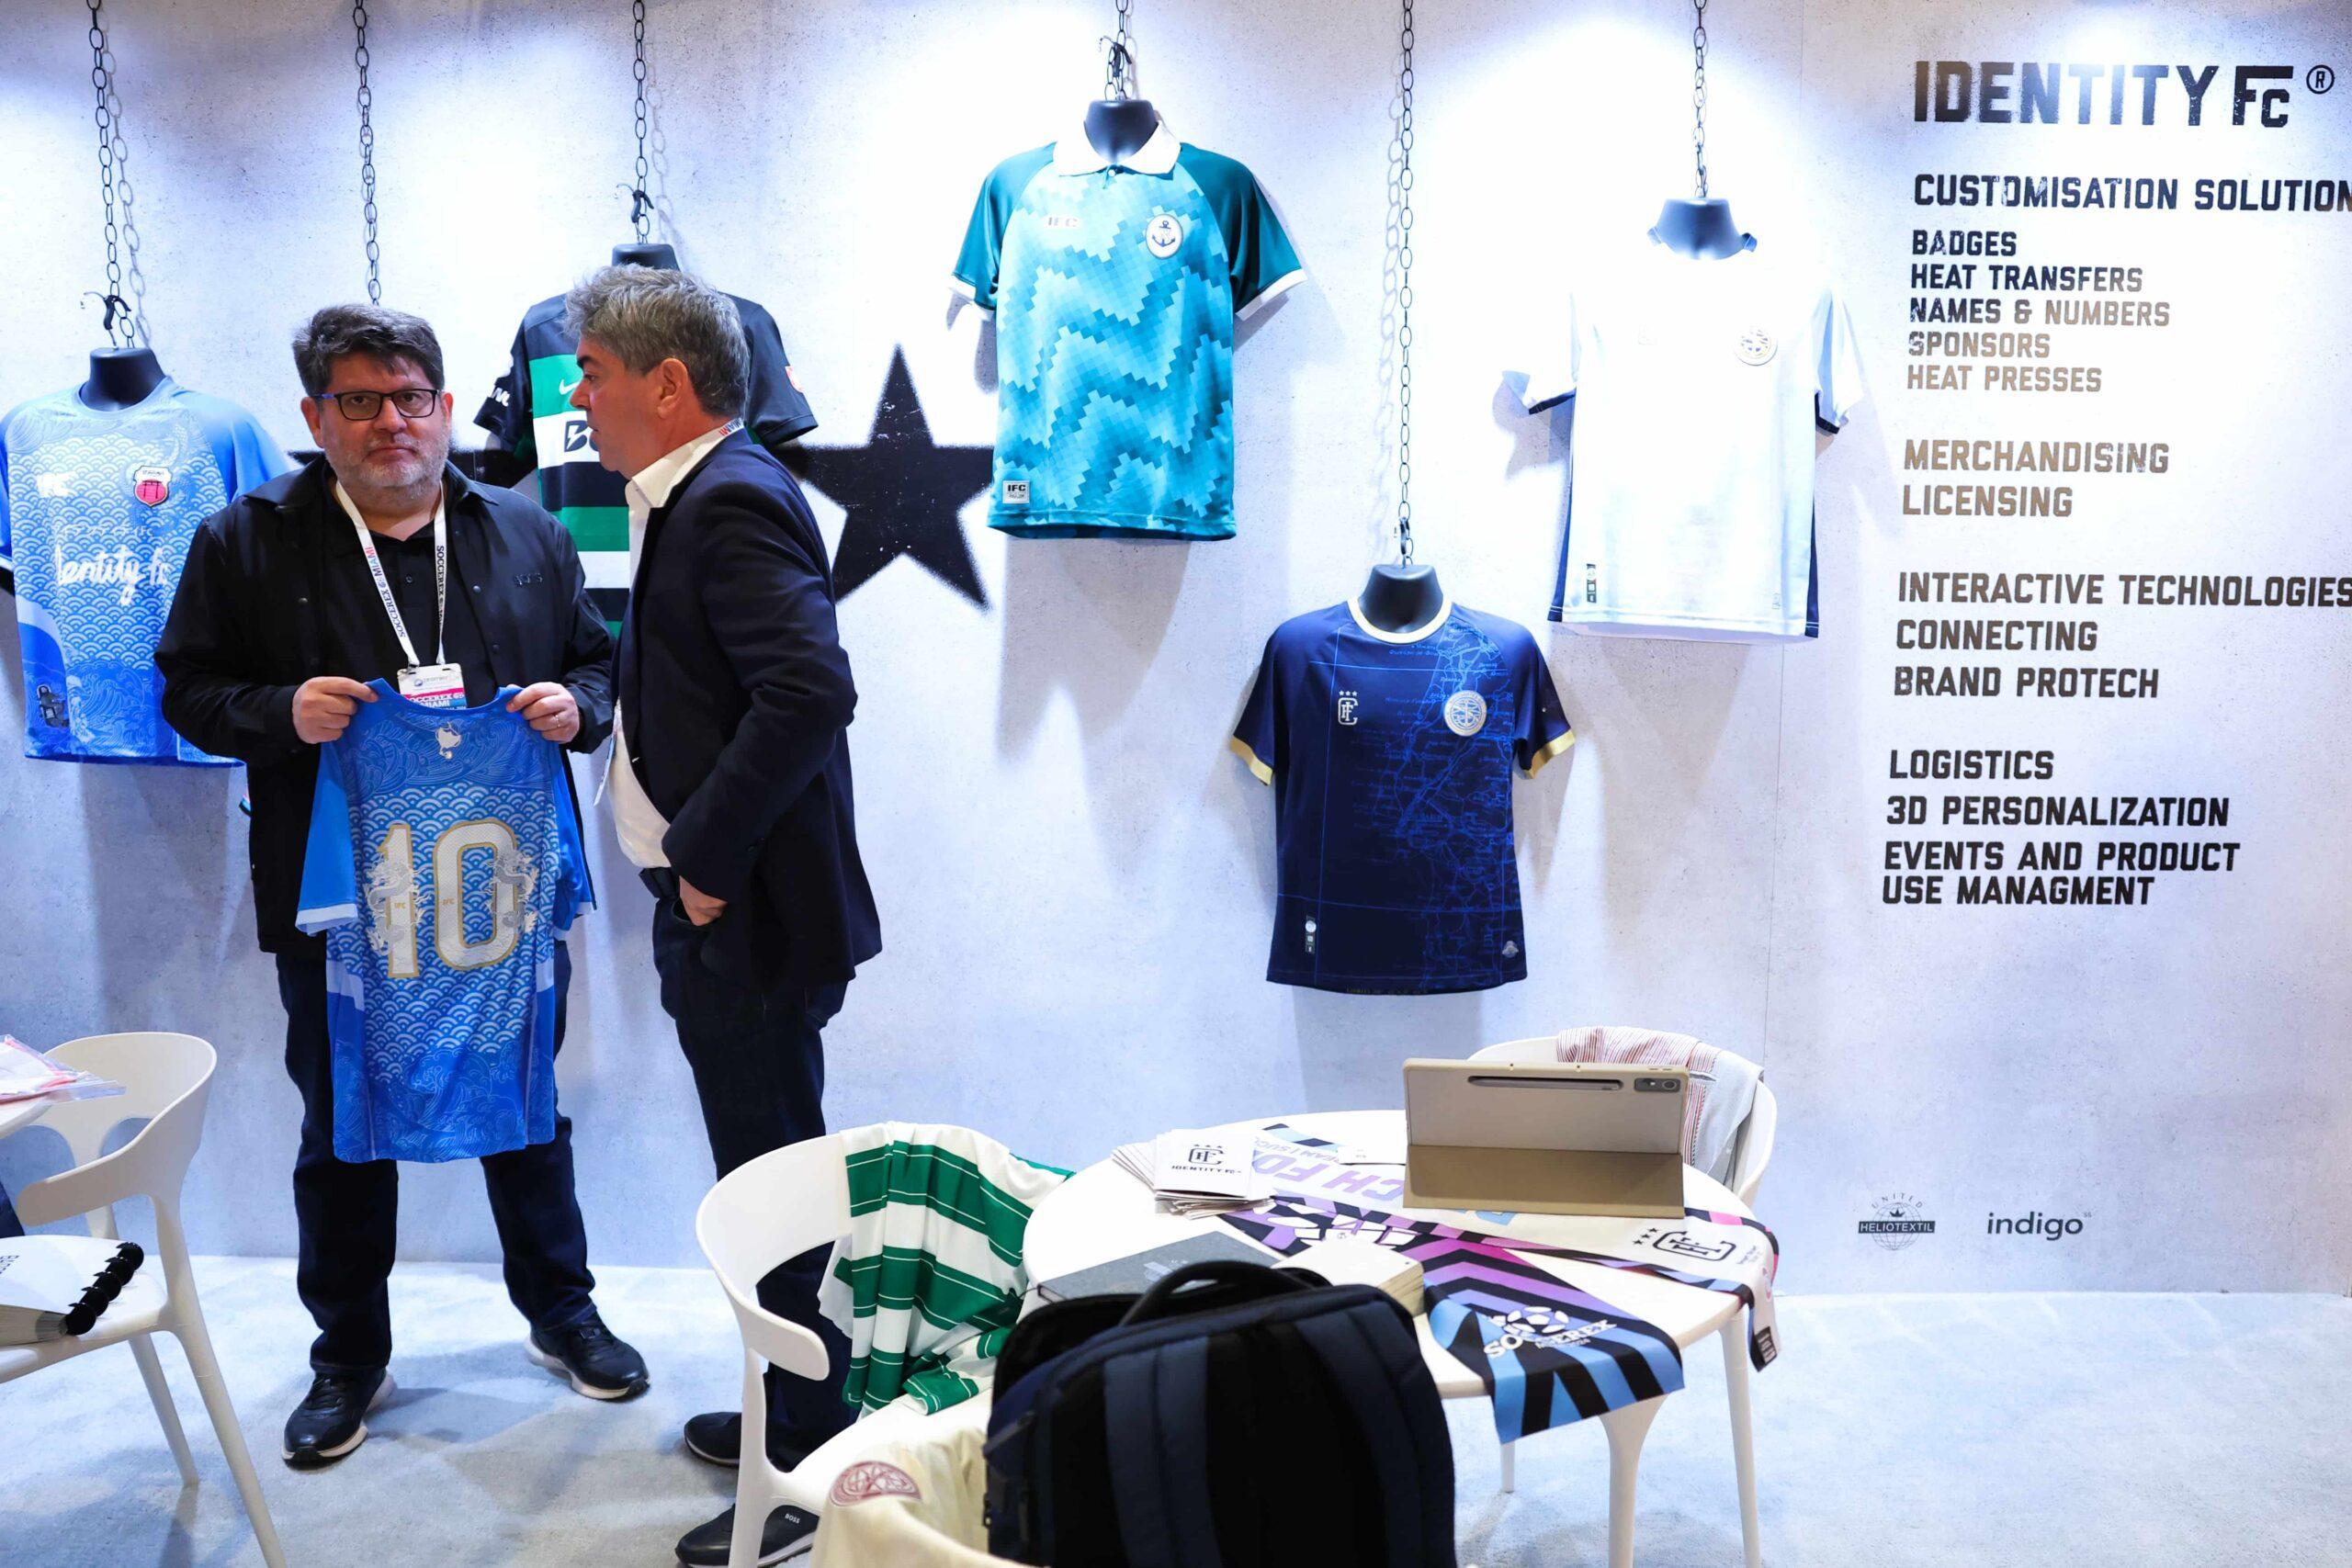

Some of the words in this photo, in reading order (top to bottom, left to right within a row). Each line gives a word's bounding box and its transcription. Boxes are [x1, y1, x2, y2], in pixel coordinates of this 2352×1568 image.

[1915, 62, 2219, 126] IDENTITY
[1915, 175, 2177, 209] CUSTOMISATION
[1912, 230, 2017, 256] BADGES
[1911, 264, 1977, 289] HEAT
[1989, 265, 2143, 292] TRANSFERS
[1909, 298, 2001, 323] NAMES
[2014, 299, 2032, 324] &
[2044, 300, 2171, 326] NUMBERS
[1907, 331, 2051, 358] SPONSORS
[1906, 365, 1973, 390] HEAT
[1984, 366, 2102, 392] PRESSES
[1904, 439, 2169, 473] MERCHANDISING
[1008, 484, 1026, 492] IFC
[1903, 485, 2073, 517] LICENSING
[365, 546, 382, 577] MIAMI
[435, 546, 445, 596] SOCCEREX
[1898, 572, 2104, 604] INTERACTIVE
[2119, 575, 2352, 607] TECHNOLOGIES
[381, 588, 406, 637] SOCCEREX
[1896, 619, 2098, 650] CONNECTING
[1894, 666, 2001, 696] BRAND
[2017, 668, 2159, 698] PROTECH
[1889, 750, 2054, 780] LOGISTICS
[1886, 795, 1927, 826] 3D
[1942, 796, 2230, 827] PERSONALIZATION
[1884, 840, 2004, 870] EVENTS
[2017, 841, 2082, 871] AND
[2097, 842, 2241, 872] PRODUCT
[377, 817, 522, 978] 10
[1882, 875, 1943, 904] USE
[1956, 875, 2155, 906] MANAGMENT
[1171, 1165, 1222, 1173] IDENTITY
[1860, 1222, 1933, 1233] HELIOTEXTIL
[1987, 1212, 2084, 1241] indigo
